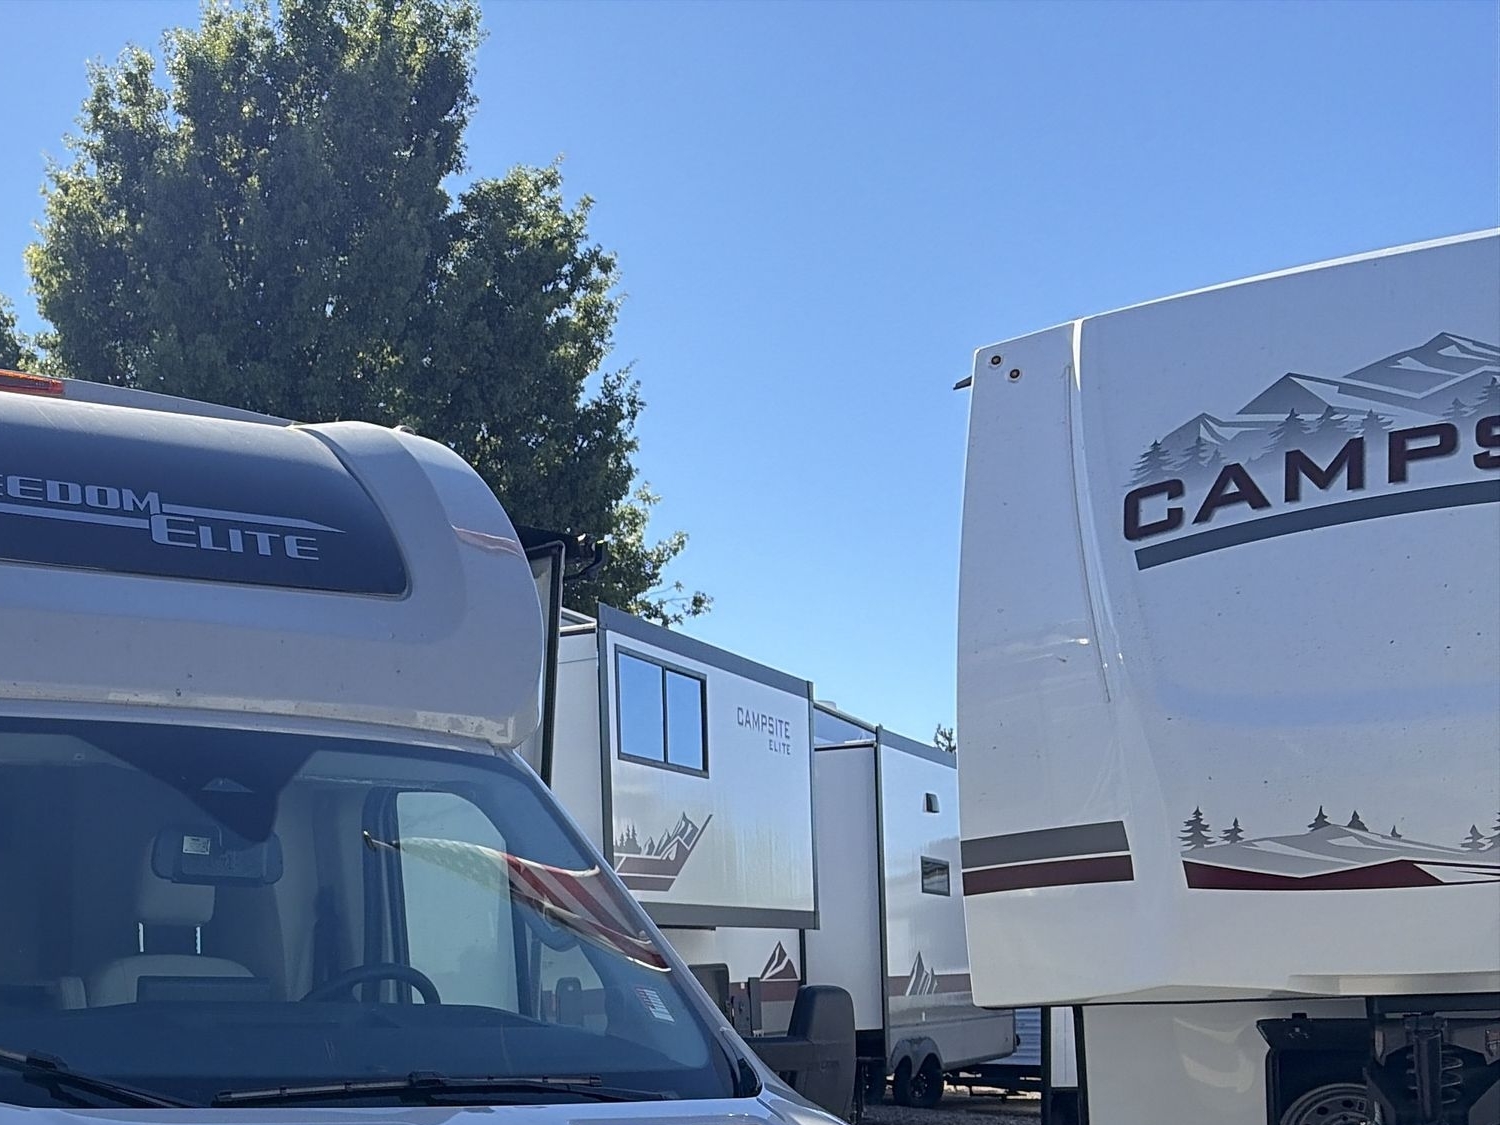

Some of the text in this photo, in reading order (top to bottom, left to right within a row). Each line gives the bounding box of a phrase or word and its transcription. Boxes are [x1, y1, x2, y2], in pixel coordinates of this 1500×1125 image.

[151, 513, 320, 561] ELITE
[737, 706, 791, 740] CAMPSITE
[769, 739, 791, 756] ELITE
